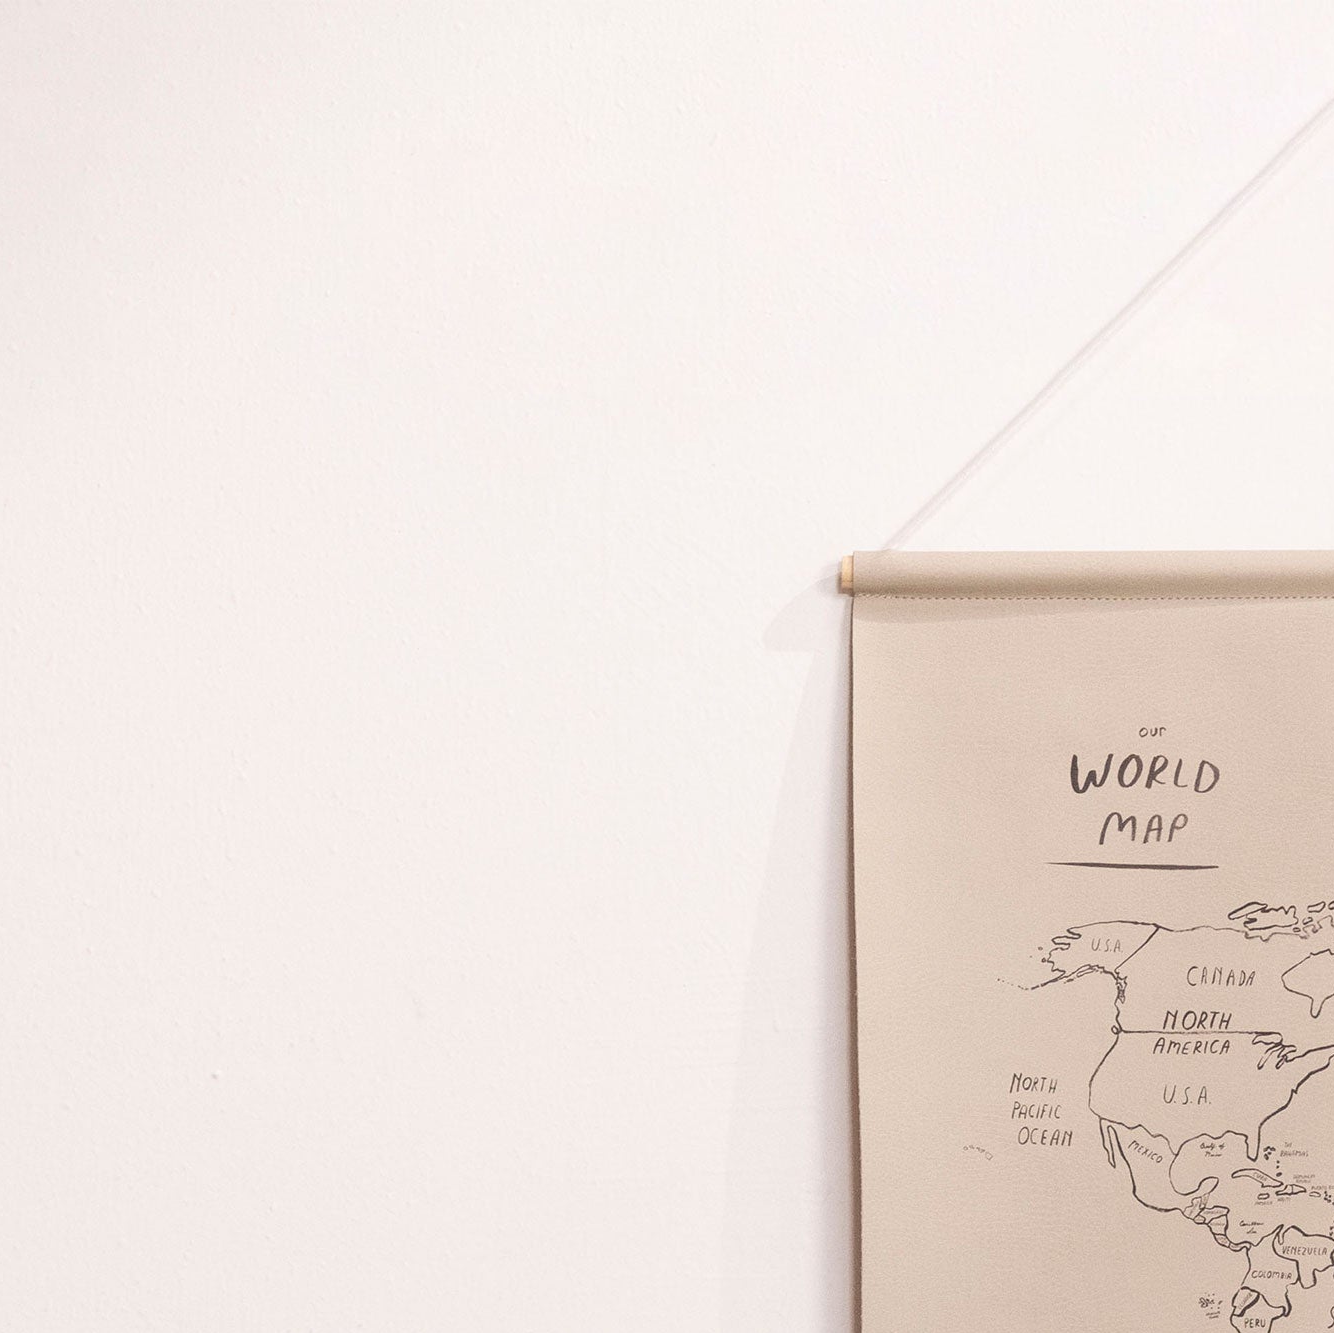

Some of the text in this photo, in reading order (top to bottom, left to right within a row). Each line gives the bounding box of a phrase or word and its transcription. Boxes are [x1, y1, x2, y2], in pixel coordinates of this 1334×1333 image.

[1070, 754, 1220, 794] WORLD
[1099, 812, 1189, 845] MAP
[1186, 965, 1257, 988] CANADA
[1163, 1010, 1233, 1031] NORTH
[1152, 1037, 1231, 1056] AMERICA
[1010, 1072, 1058, 1094] NORTH
[1163, 1085, 1212, 1105] U.S.A.
[1011, 1102, 1062, 1121] PACIFIC
[1018, 1126, 1072, 1147] OCEAN
[1128, 1140, 1163, 1164] MEXICO
[1281, 1244, 1328, 1257] VENEZUELA
[1251, 1270, 1293, 1281] COLOMBIA
[1244, 1317, 1267, 1330] PERU
